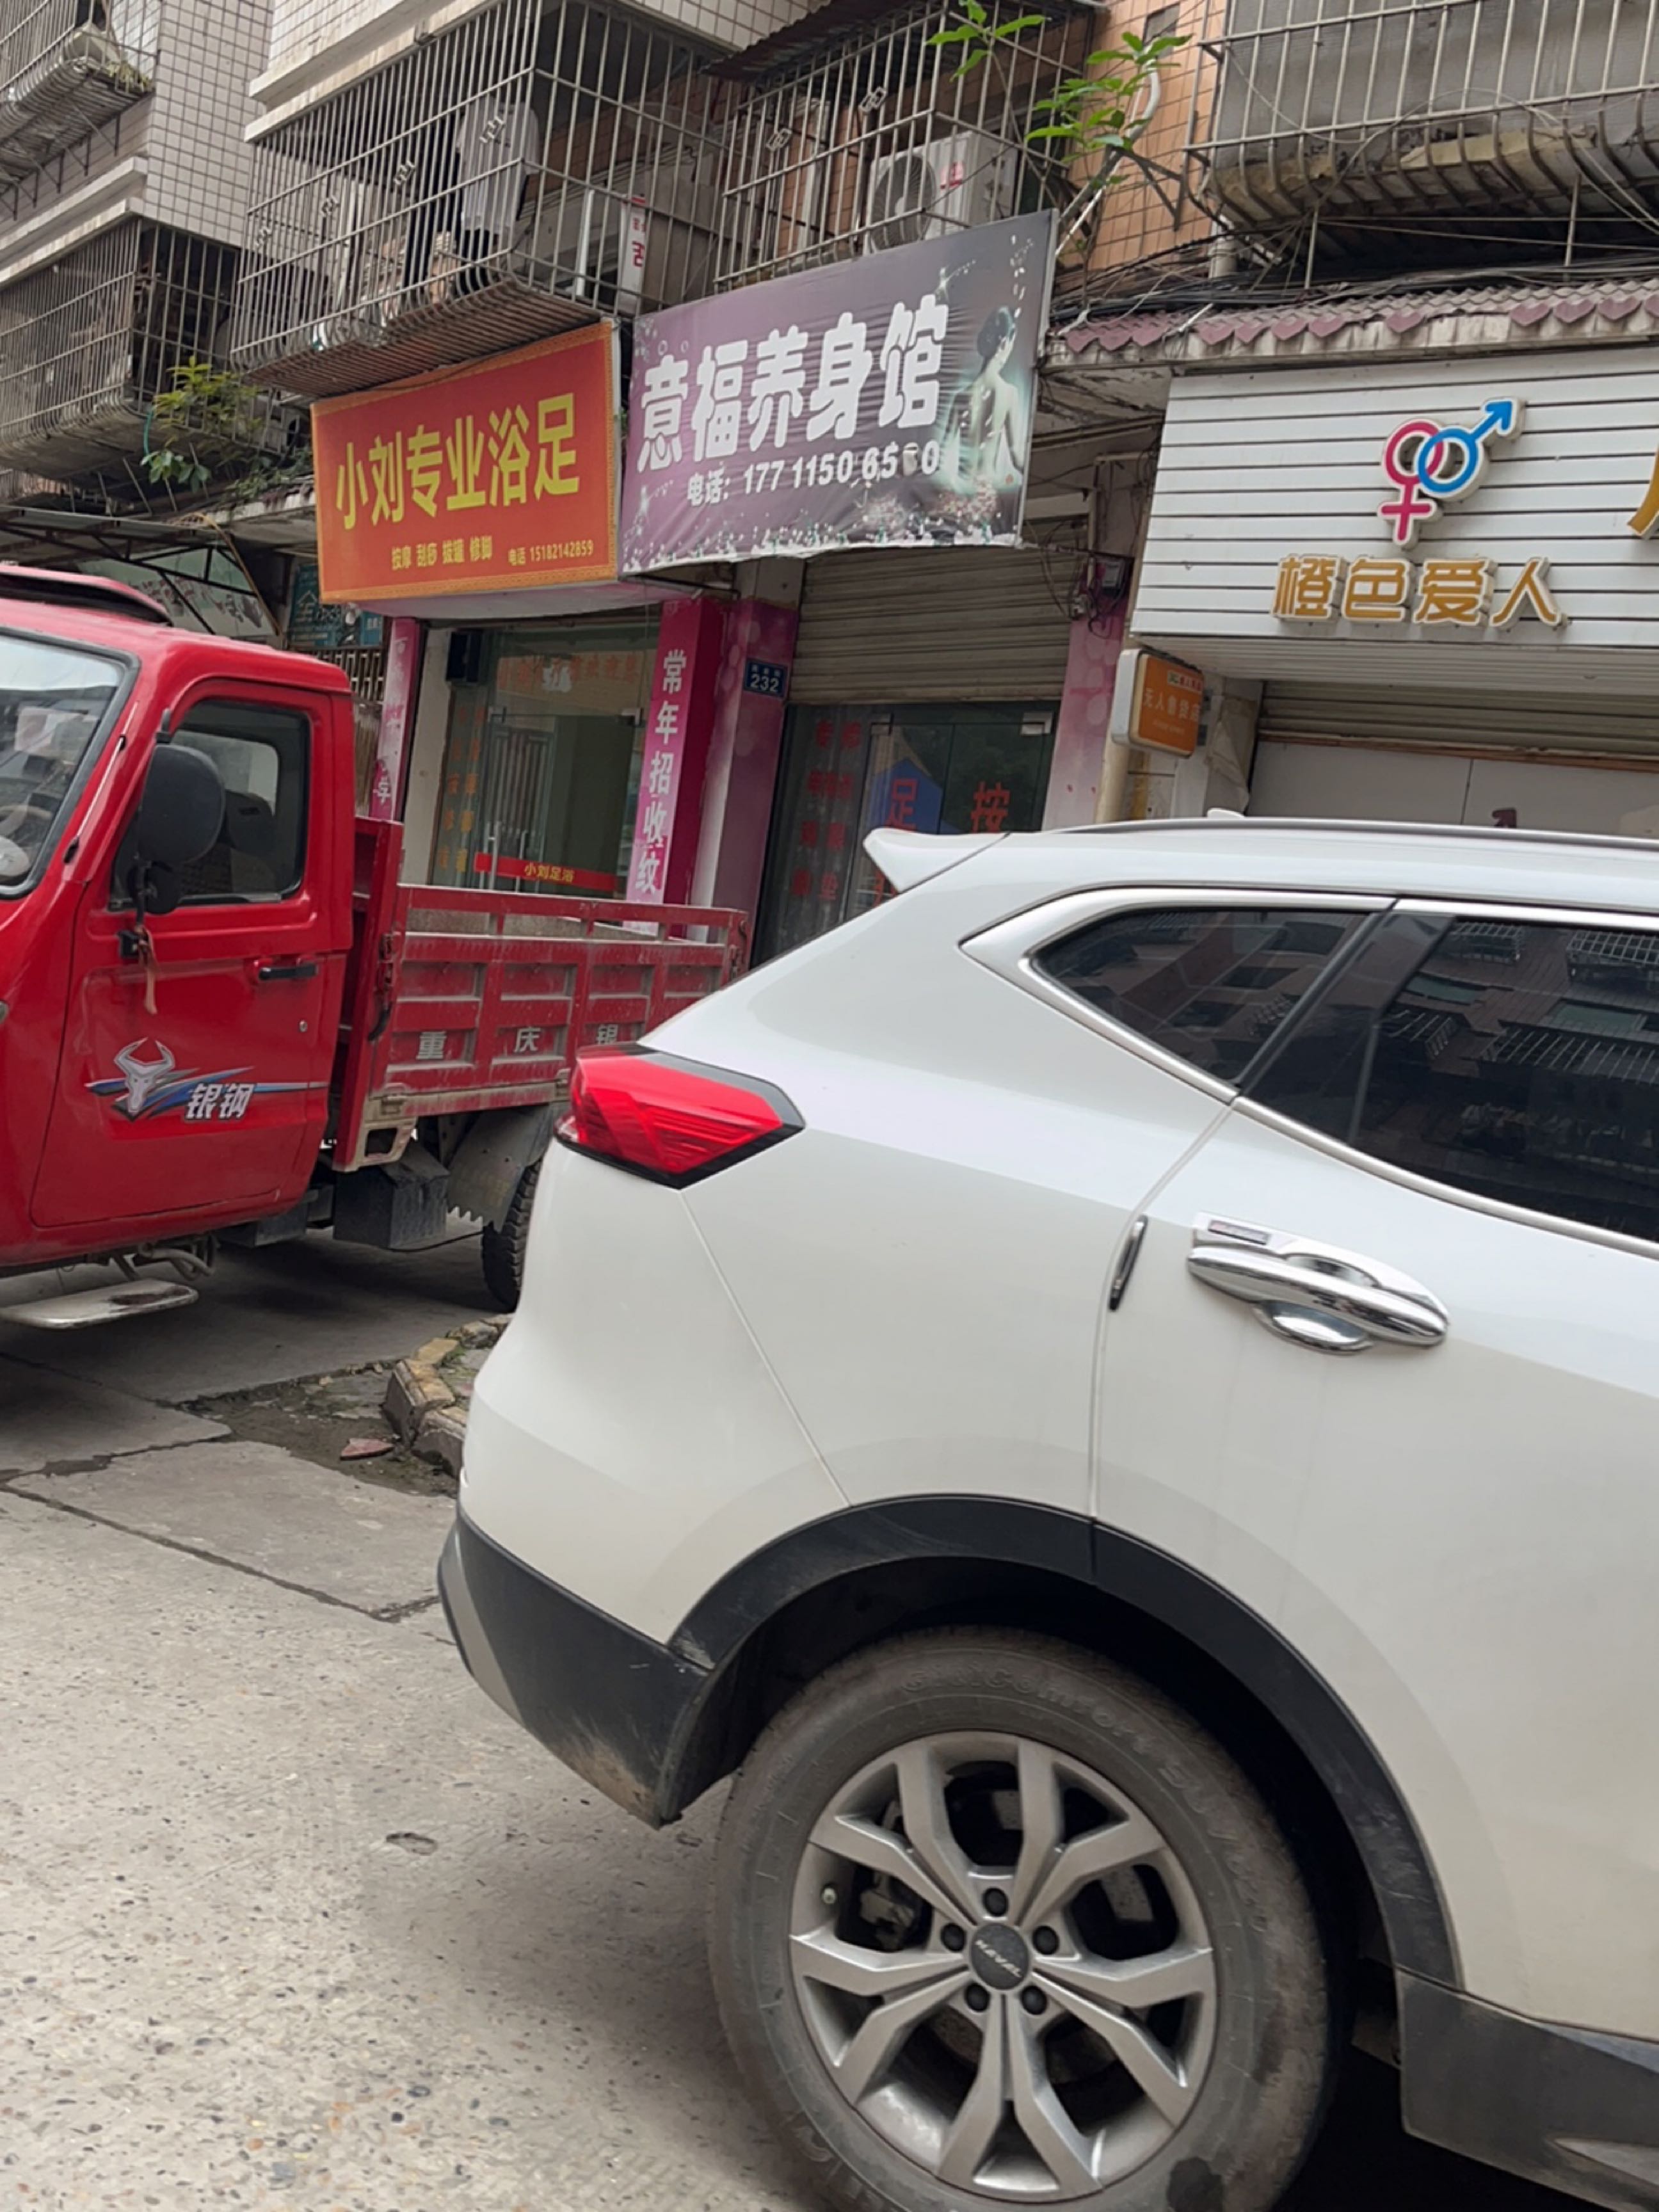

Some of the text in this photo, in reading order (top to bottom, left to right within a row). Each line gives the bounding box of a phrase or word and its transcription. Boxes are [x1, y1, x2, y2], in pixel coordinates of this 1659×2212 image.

[637, 294, 949, 472] 意福养身馆
[336, 392, 579, 530] 小刘专业浴足
[744, 461, 785, 494] 177
[792, 450, 853, 488] 1150
[1273, 554, 1566, 627] 橙色爱人
[750, 673, 780, 693] 232
[630, 648, 687, 933] 常年招收纹
[186, 1082, 255, 1119] 银钢
